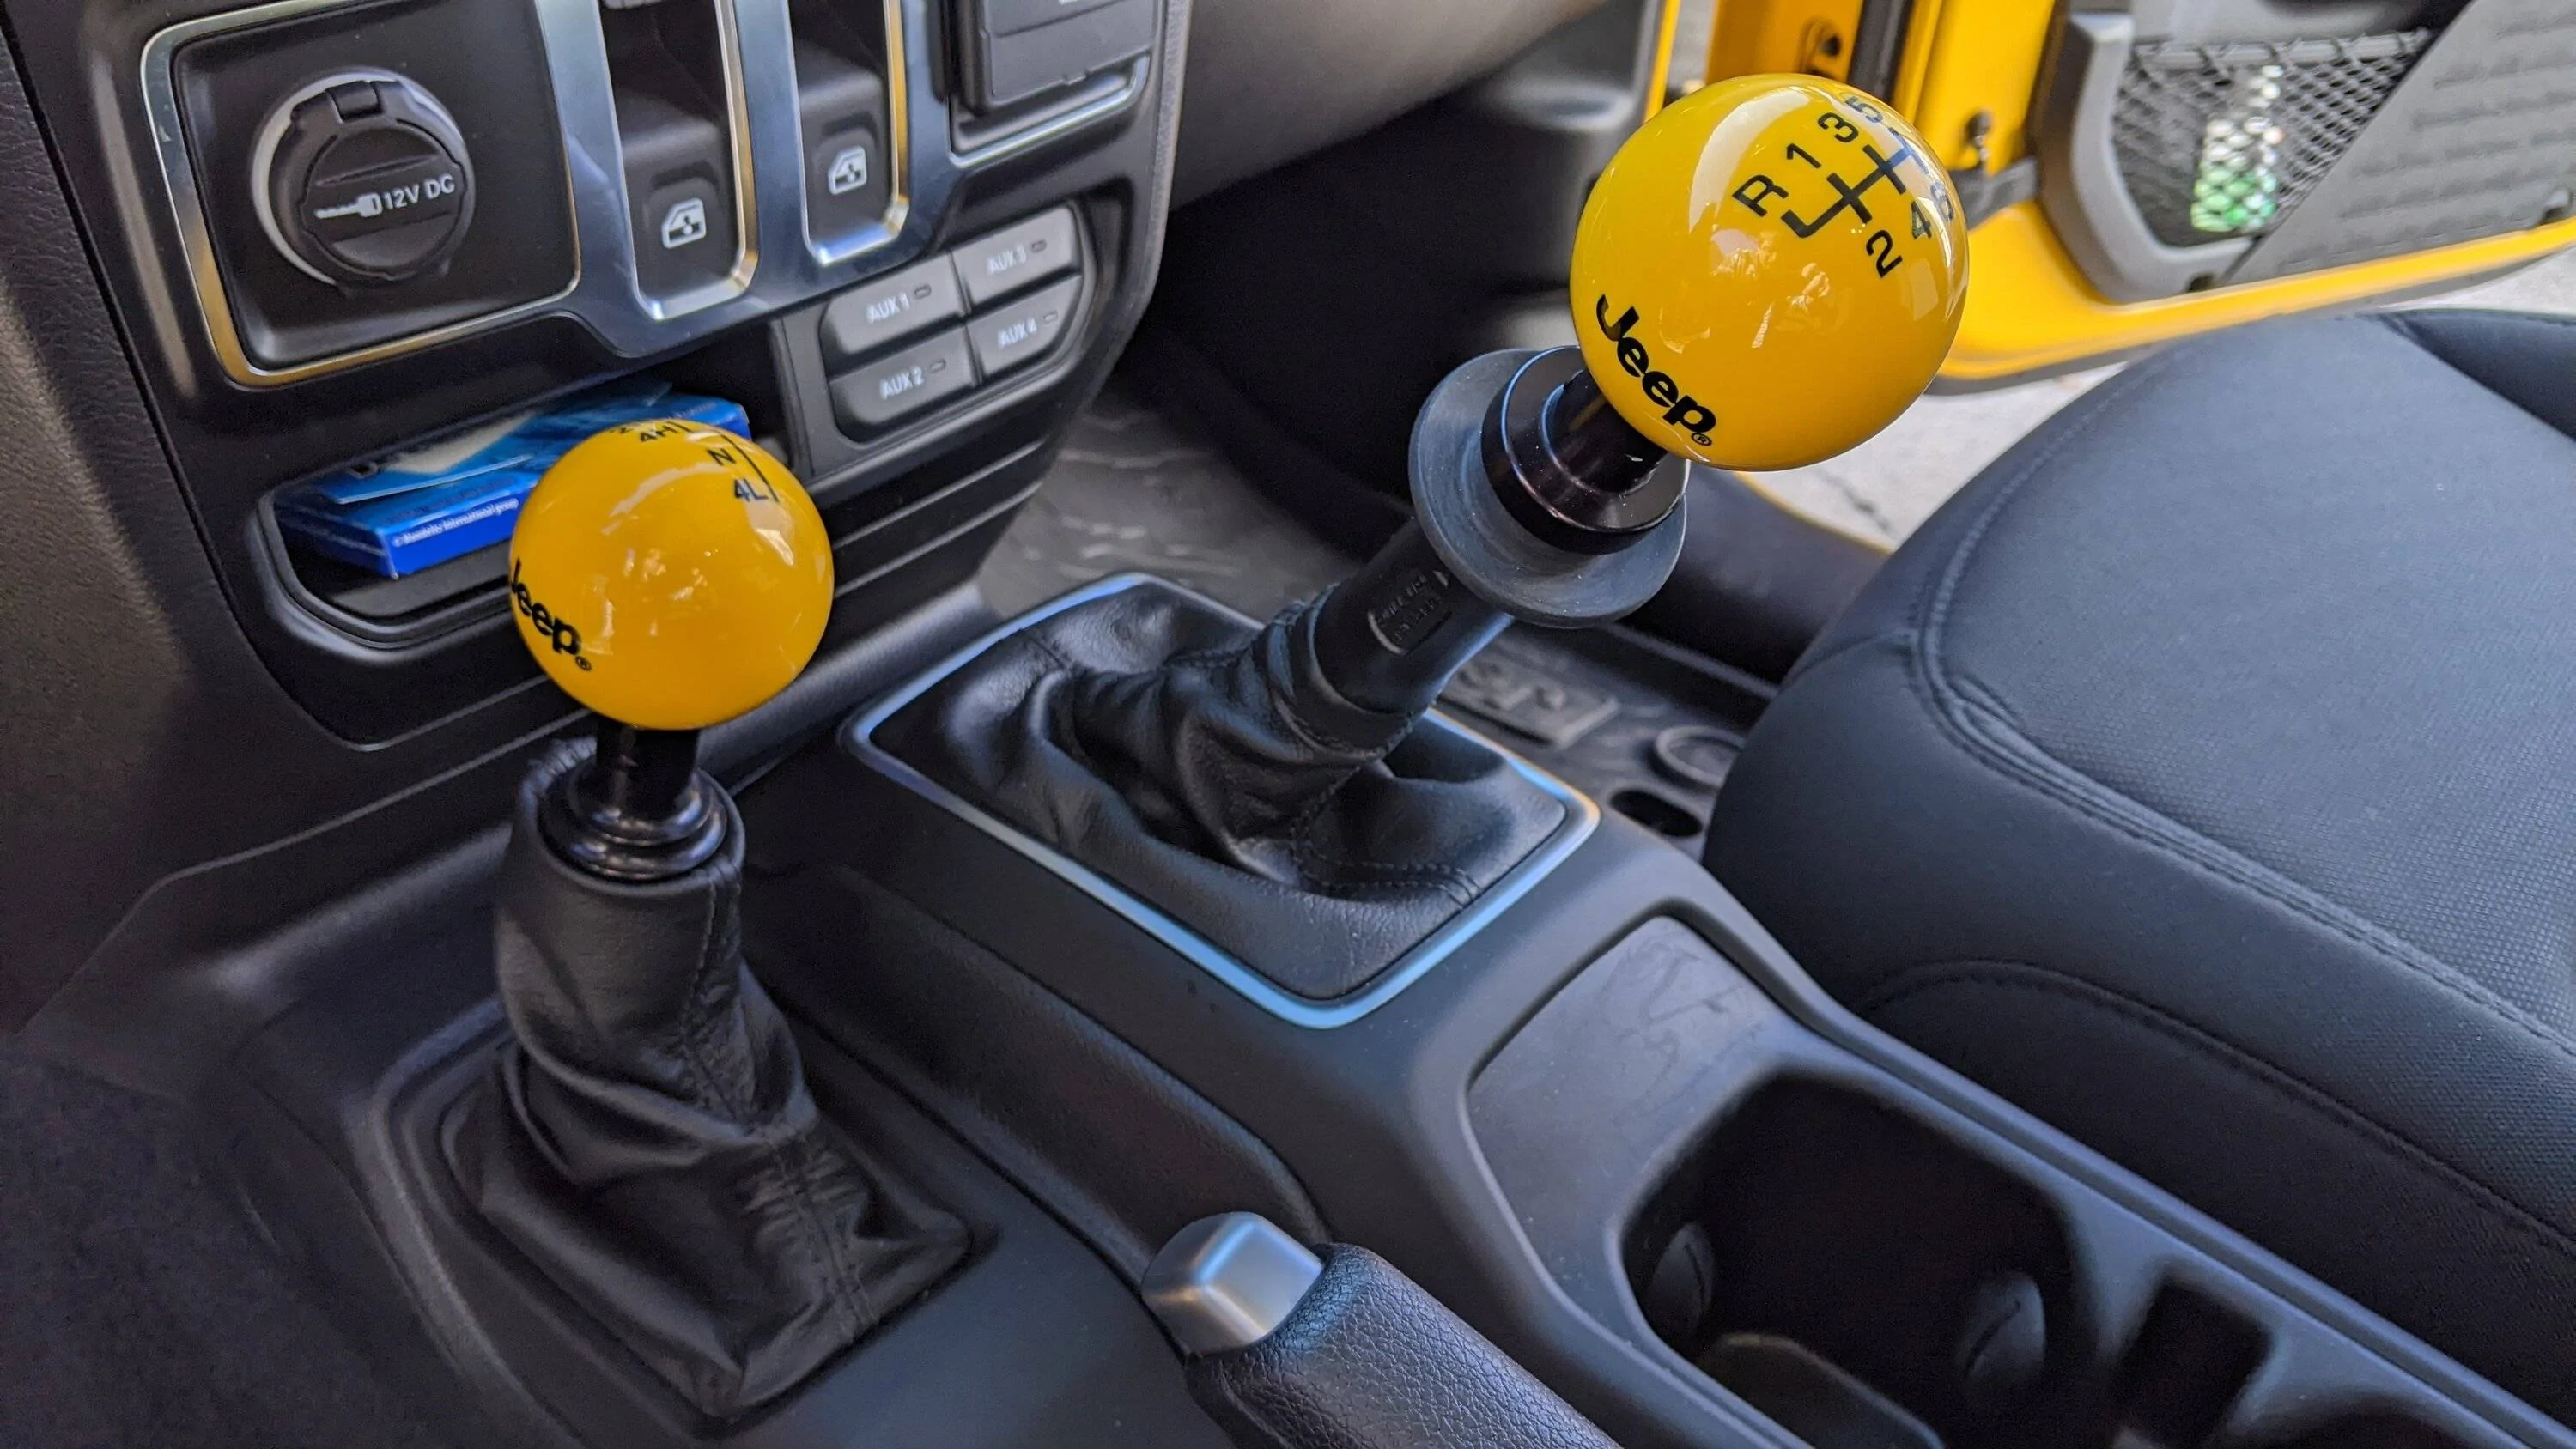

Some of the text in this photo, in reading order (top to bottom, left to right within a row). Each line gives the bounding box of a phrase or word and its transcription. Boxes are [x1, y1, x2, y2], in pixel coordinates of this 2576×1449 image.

[1732, 96, 1884, 217] R 1 3 5
[382, 173, 456, 210] 12V DC
[1866, 229, 1903, 278] 2
[1911, 201, 1932, 239] 4
[987, 252, 1018, 274] AUX
[866, 293, 910, 324] AUX 1
[997, 318, 1038, 349] AUX 4
[879, 368, 925, 400] AUX 2
[706, 447, 737, 466] N
[734, 477, 769, 502] 4L
